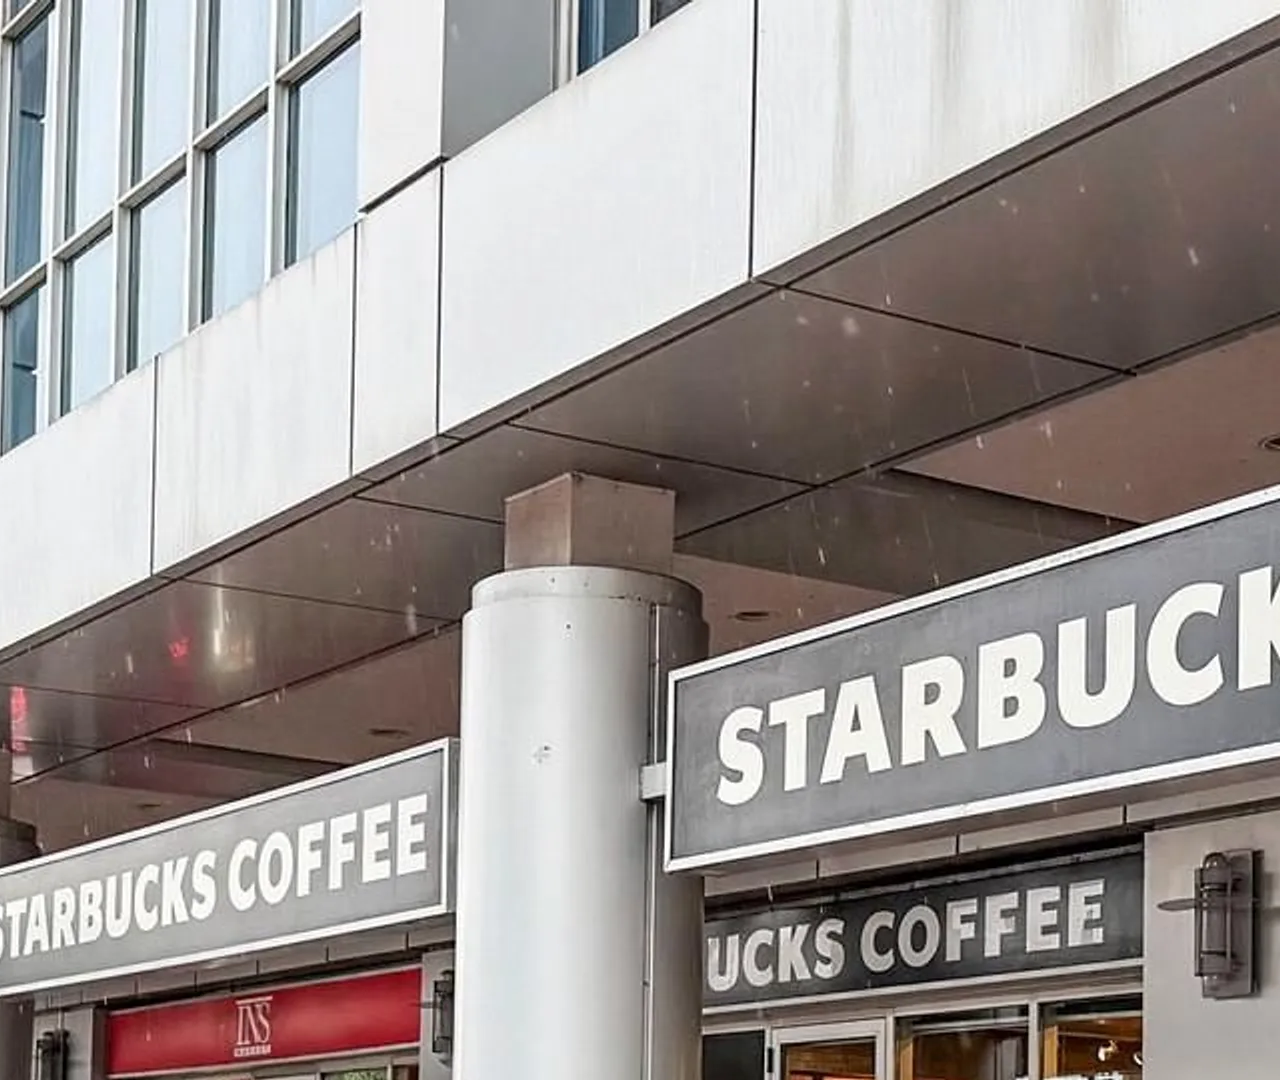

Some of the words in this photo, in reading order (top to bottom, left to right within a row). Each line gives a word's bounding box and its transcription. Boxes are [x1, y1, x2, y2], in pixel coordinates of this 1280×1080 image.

[228, 793, 428, 912] COFFEE
[859, 878, 1105, 973] COFFEE
[236, 1000, 272, 1046] INS
